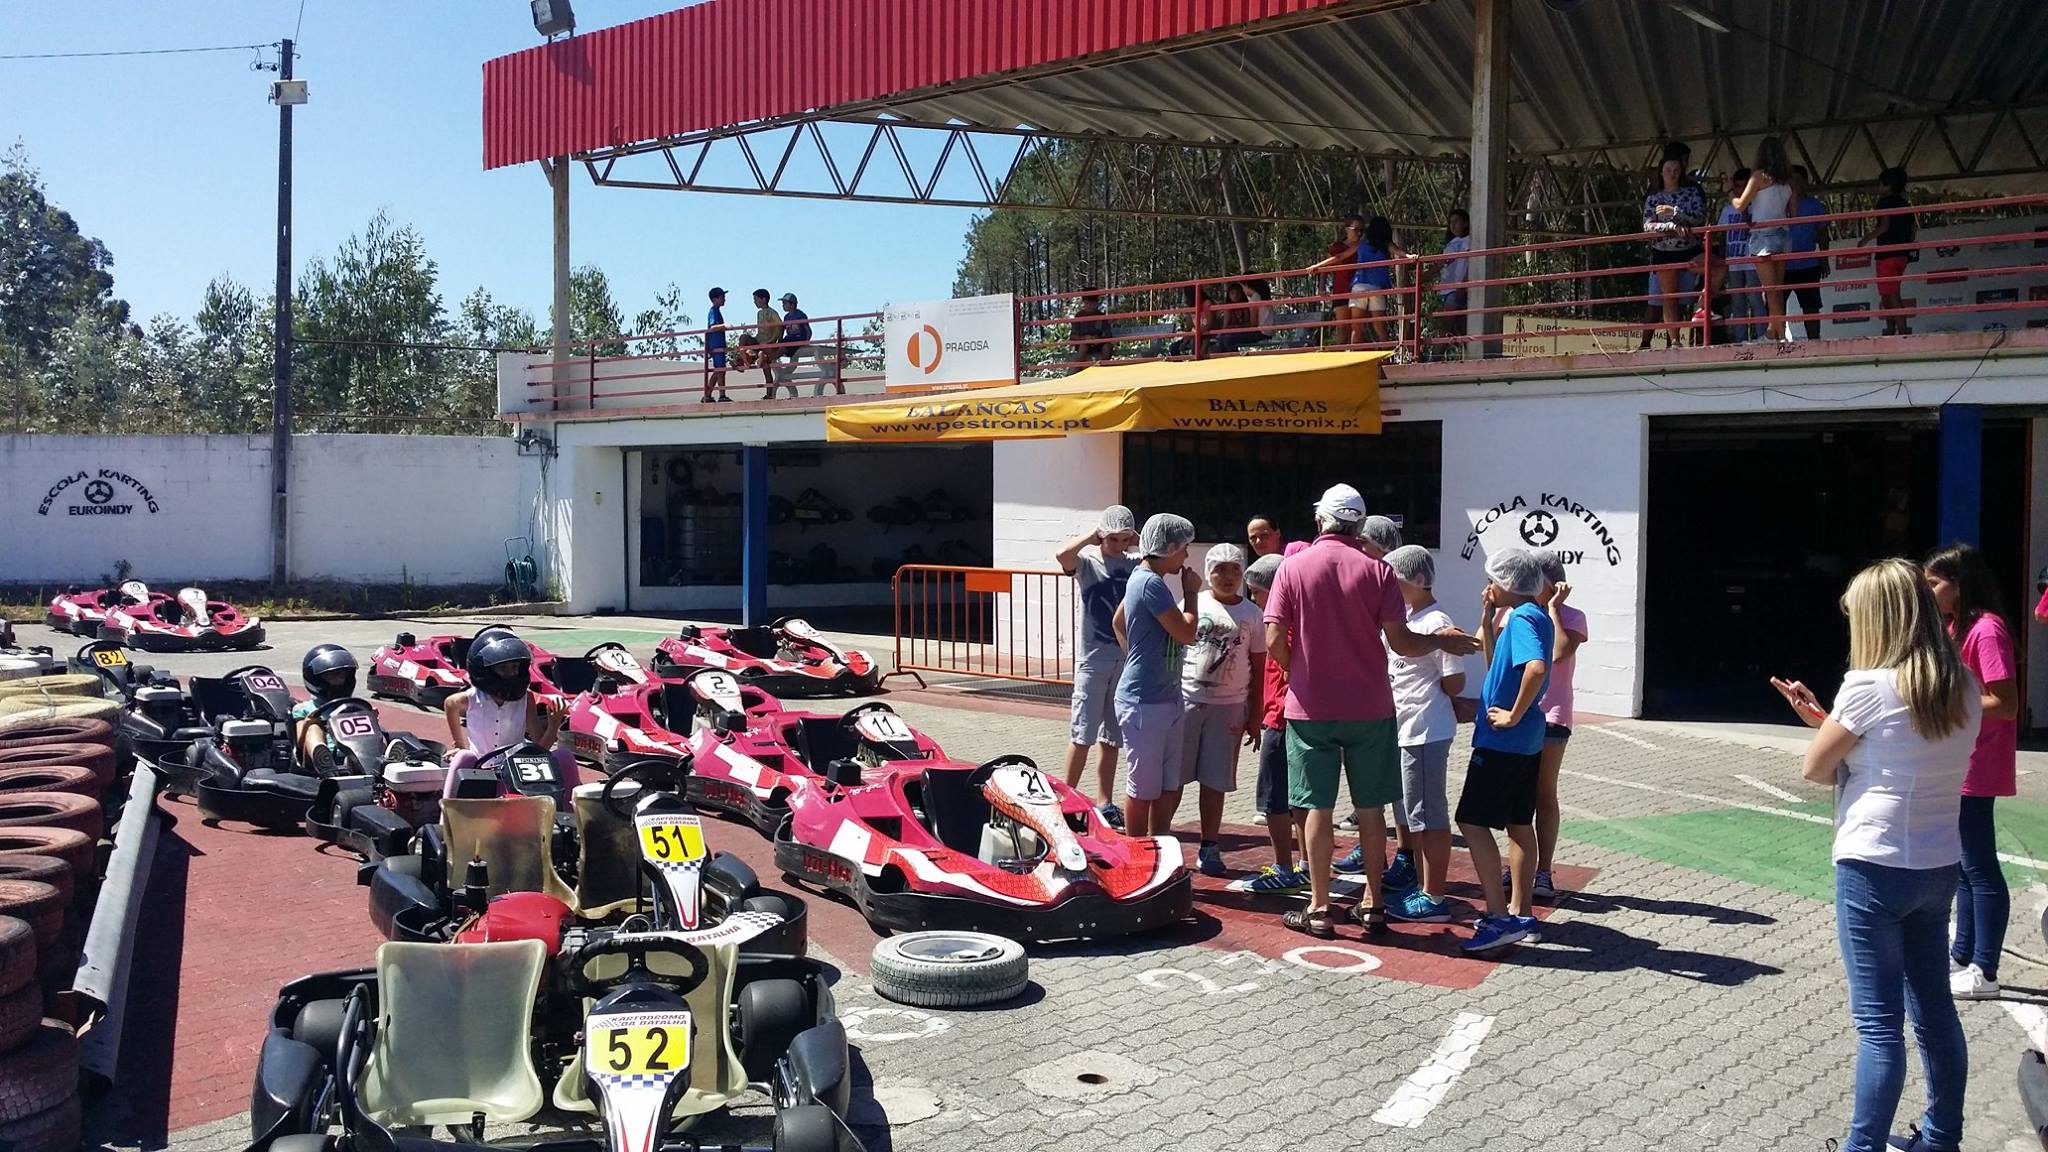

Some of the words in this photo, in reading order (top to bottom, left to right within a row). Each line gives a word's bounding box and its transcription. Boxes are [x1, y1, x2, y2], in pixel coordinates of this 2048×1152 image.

[945, 340, 989, 352] PRAGOSA
[1208, 398, 1328, 416] BALANÇAS
[872, 416, 1090, 434] www.pestronix.pt
[38, 471, 89, 516] ESCOLA
[99, 469, 160, 514] KARTING
[68, 504, 133, 516] EUROINDY
[1461, 495, 1527, 561] ESCOLA
[1540, 492, 1622, 567] KARTING
[99, 651, 123, 665] 82
[611, 652, 628, 666] 12
[253, 676, 281, 690] 04
[710, 676, 727, 690] 2
[340, 717, 372, 736] 05
[872, 715, 895, 736] 11
[519, 763, 554, 781] 31
[1020, 769, 1046, 793] 21
[651, 825, 689, 859] 51
[611, 1014, 686, 1022] KARTODROMO
